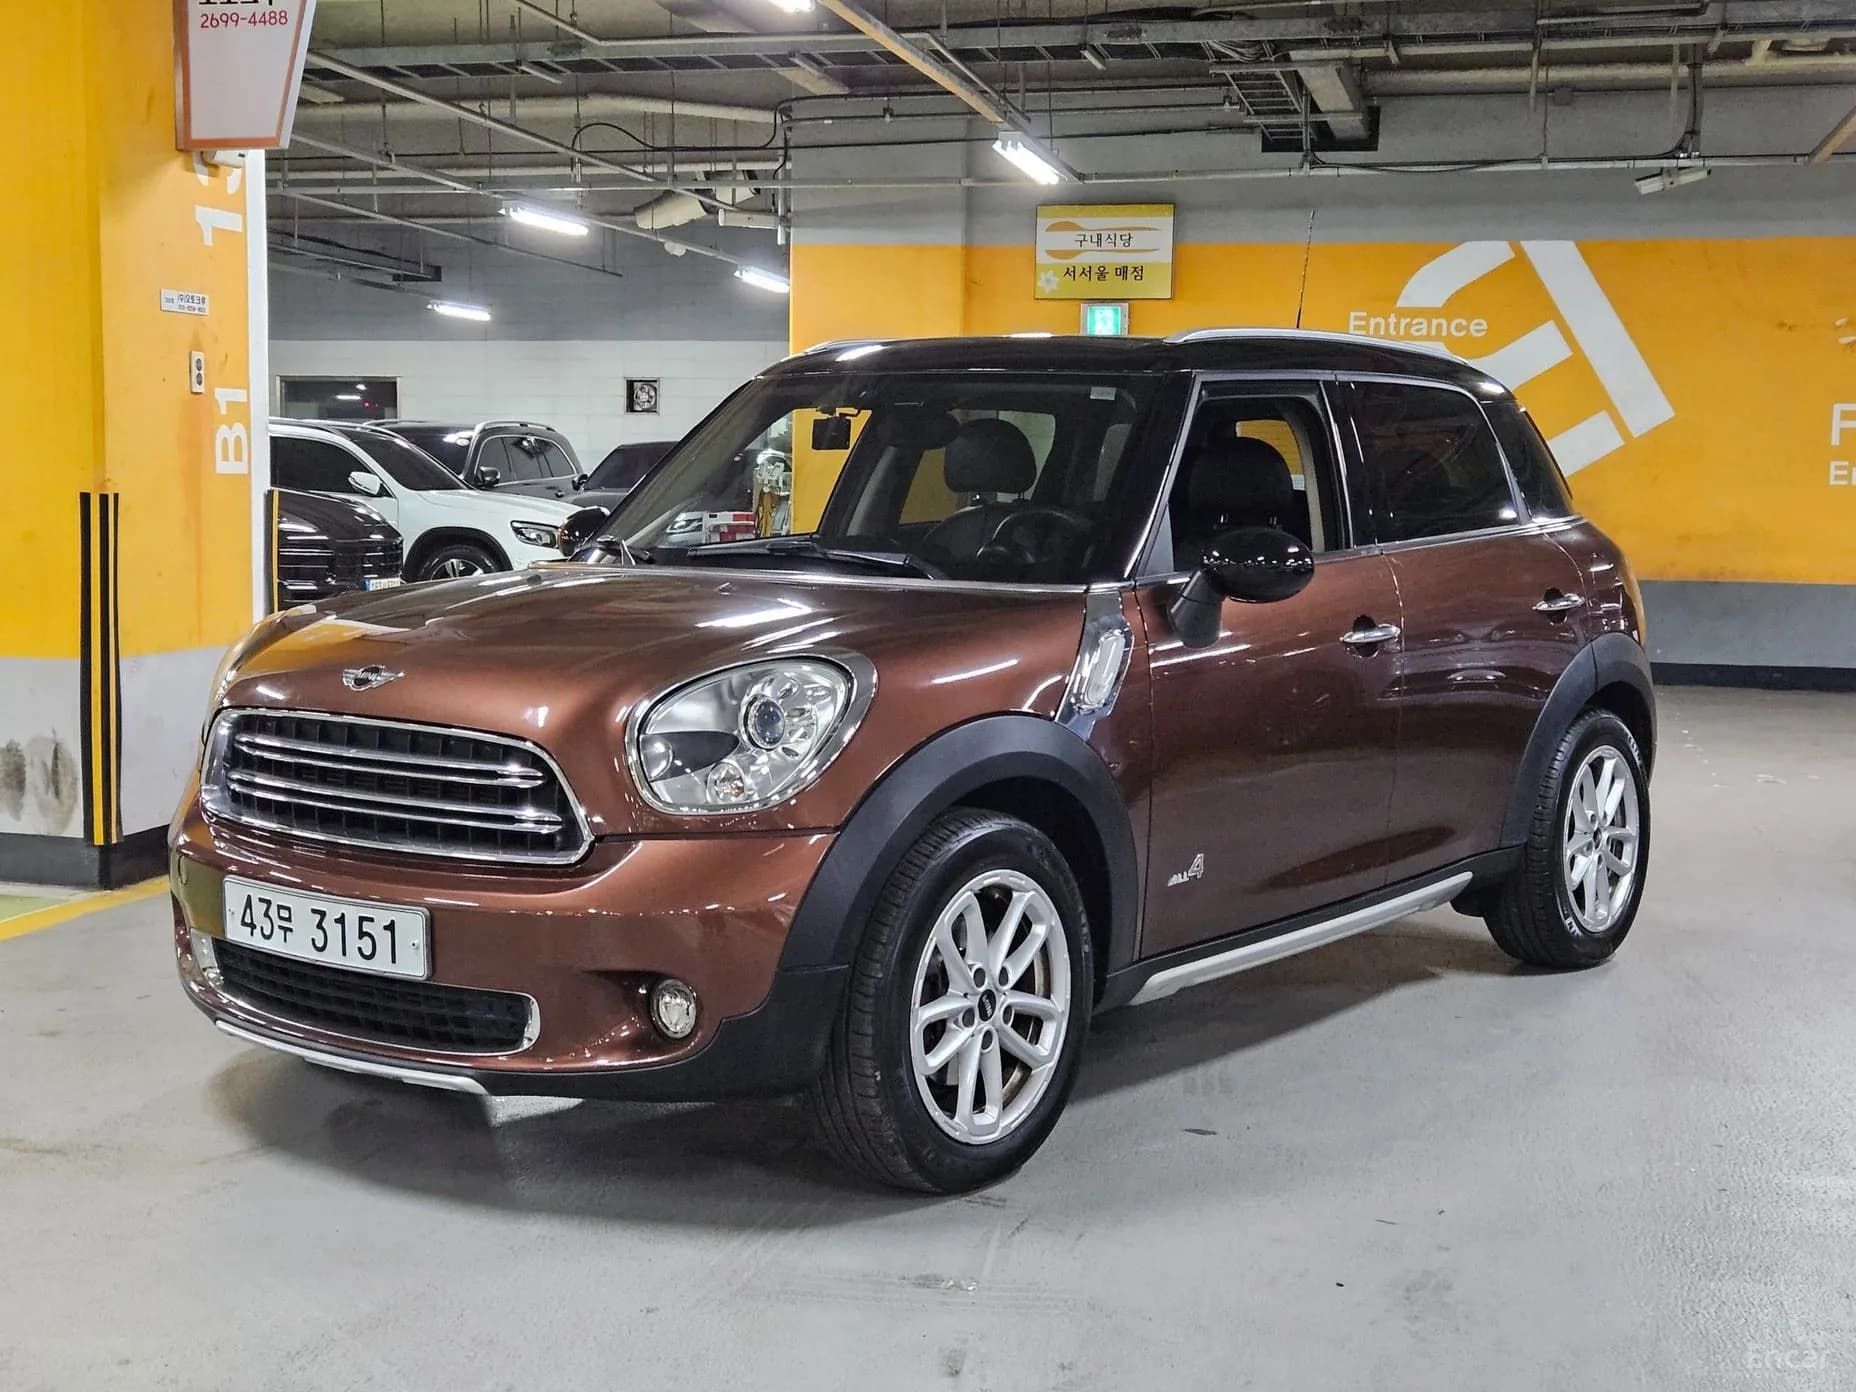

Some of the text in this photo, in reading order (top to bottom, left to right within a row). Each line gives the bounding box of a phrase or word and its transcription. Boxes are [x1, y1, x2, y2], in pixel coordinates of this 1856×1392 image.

[200, 10, 288, 28] 2699-4488
[1074, 232, 1134, 248] 구내식당
[1063, 265, 1144, 282] 서서울 매점
[1348, 311, 1488, 337] Entrance
[214, 388, 248, 475] B1
[240, 894, 397, 964] 43무 3151
